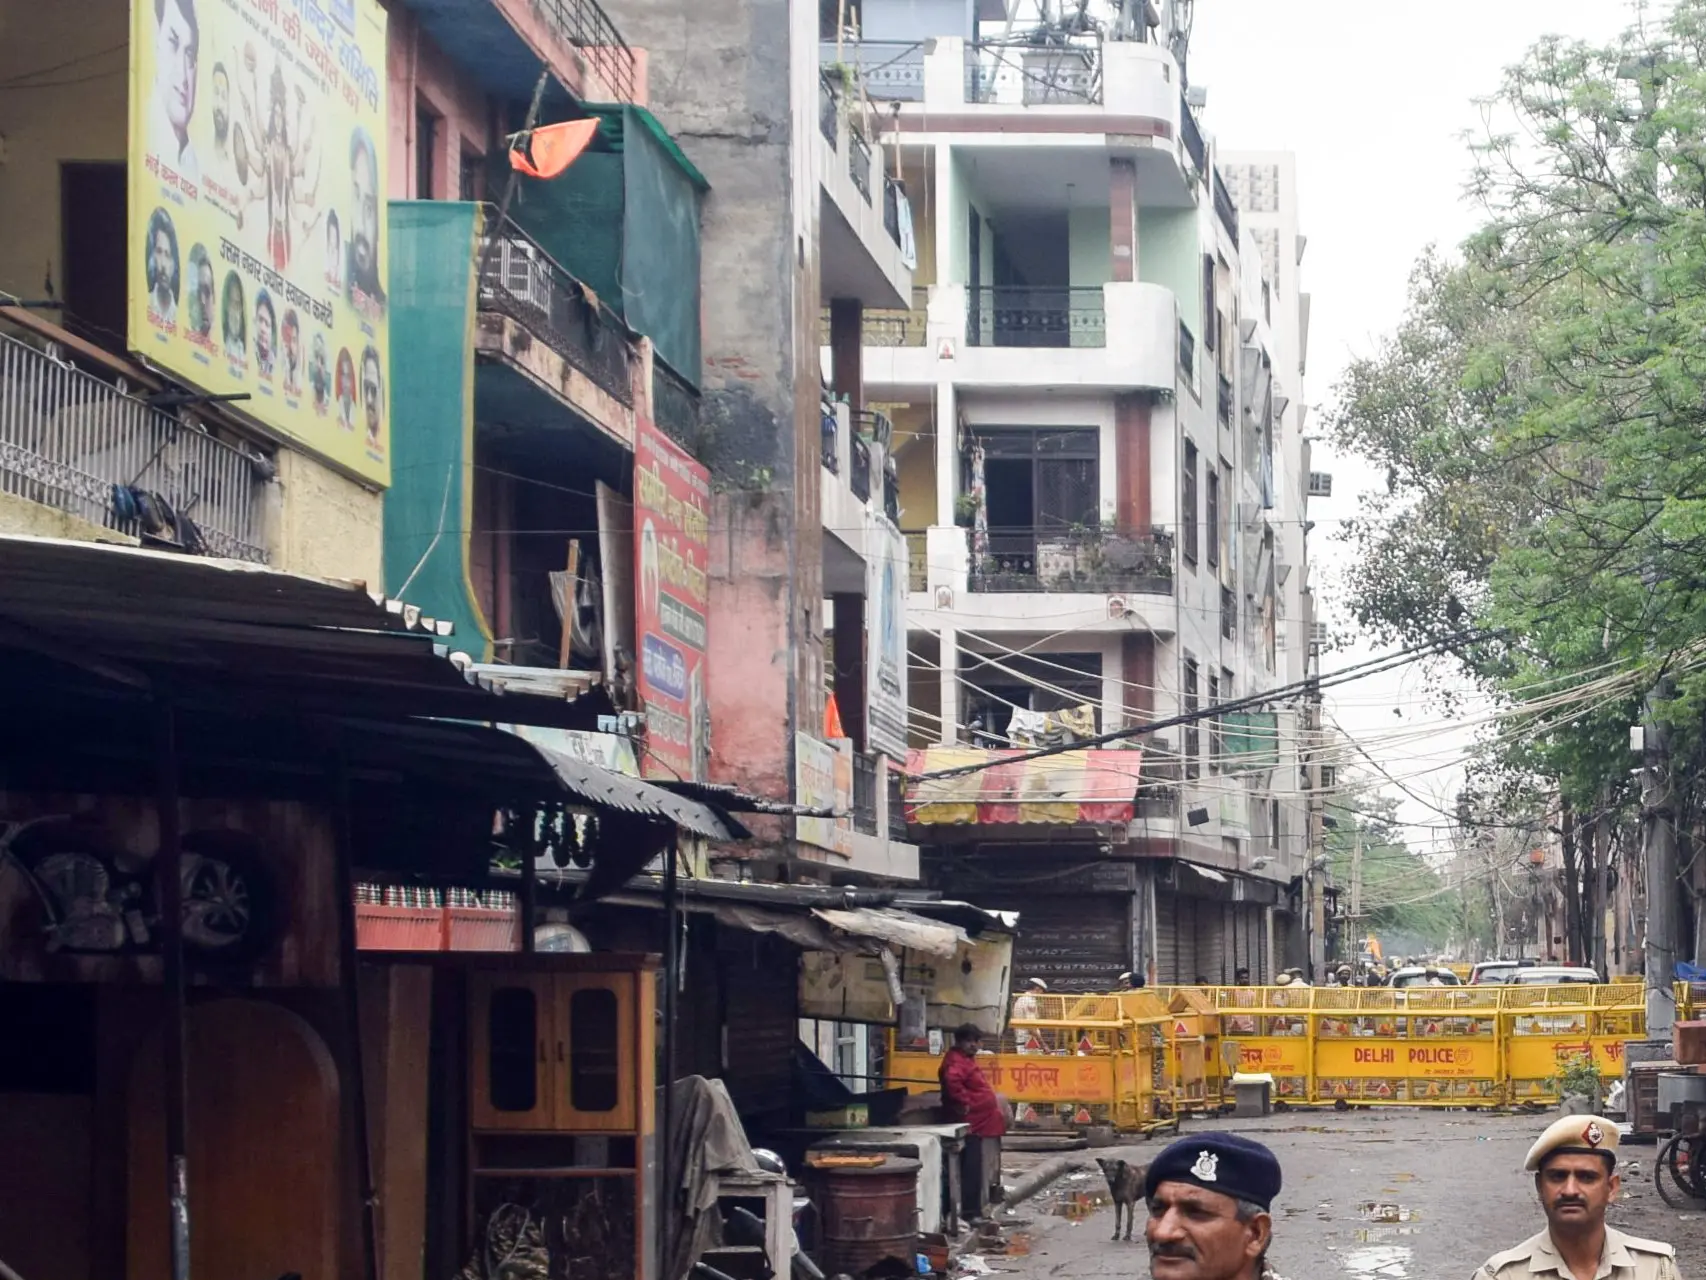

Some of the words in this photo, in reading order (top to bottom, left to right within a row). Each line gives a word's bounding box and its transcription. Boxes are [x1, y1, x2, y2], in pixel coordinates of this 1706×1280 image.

[219, 235, 241, 268] उत्तम
[1354, 1048, 1395, 1063] DELHI
[1408, 1048, 1455, 1064] POLICE
[1010, 1063, 1060, 1093] पुलिस
